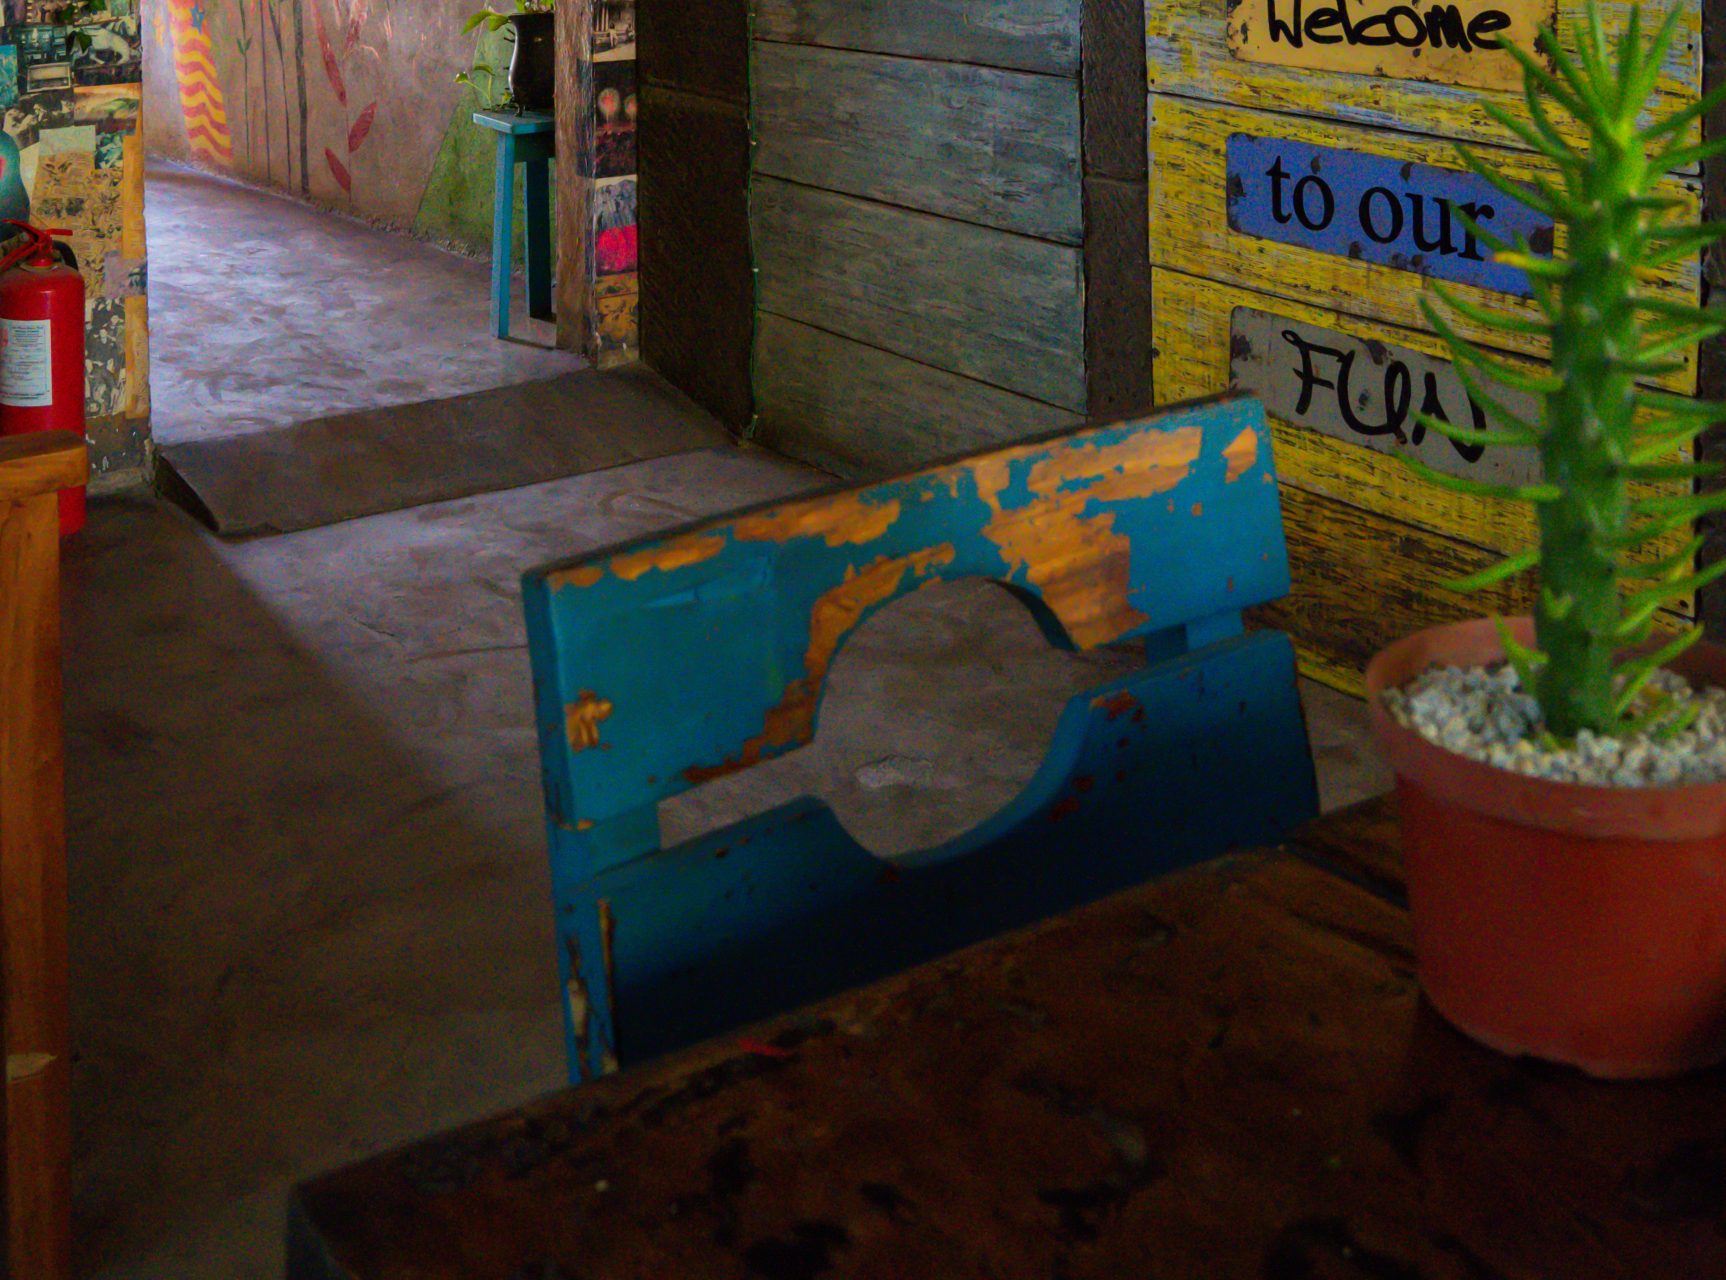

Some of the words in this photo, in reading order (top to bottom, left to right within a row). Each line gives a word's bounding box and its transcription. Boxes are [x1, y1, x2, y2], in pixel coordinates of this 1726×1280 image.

[1265, 155, 1336, 232] to
[1358, 186, 1496, 262] our
[1281, 329, 1488, 464] FUN
